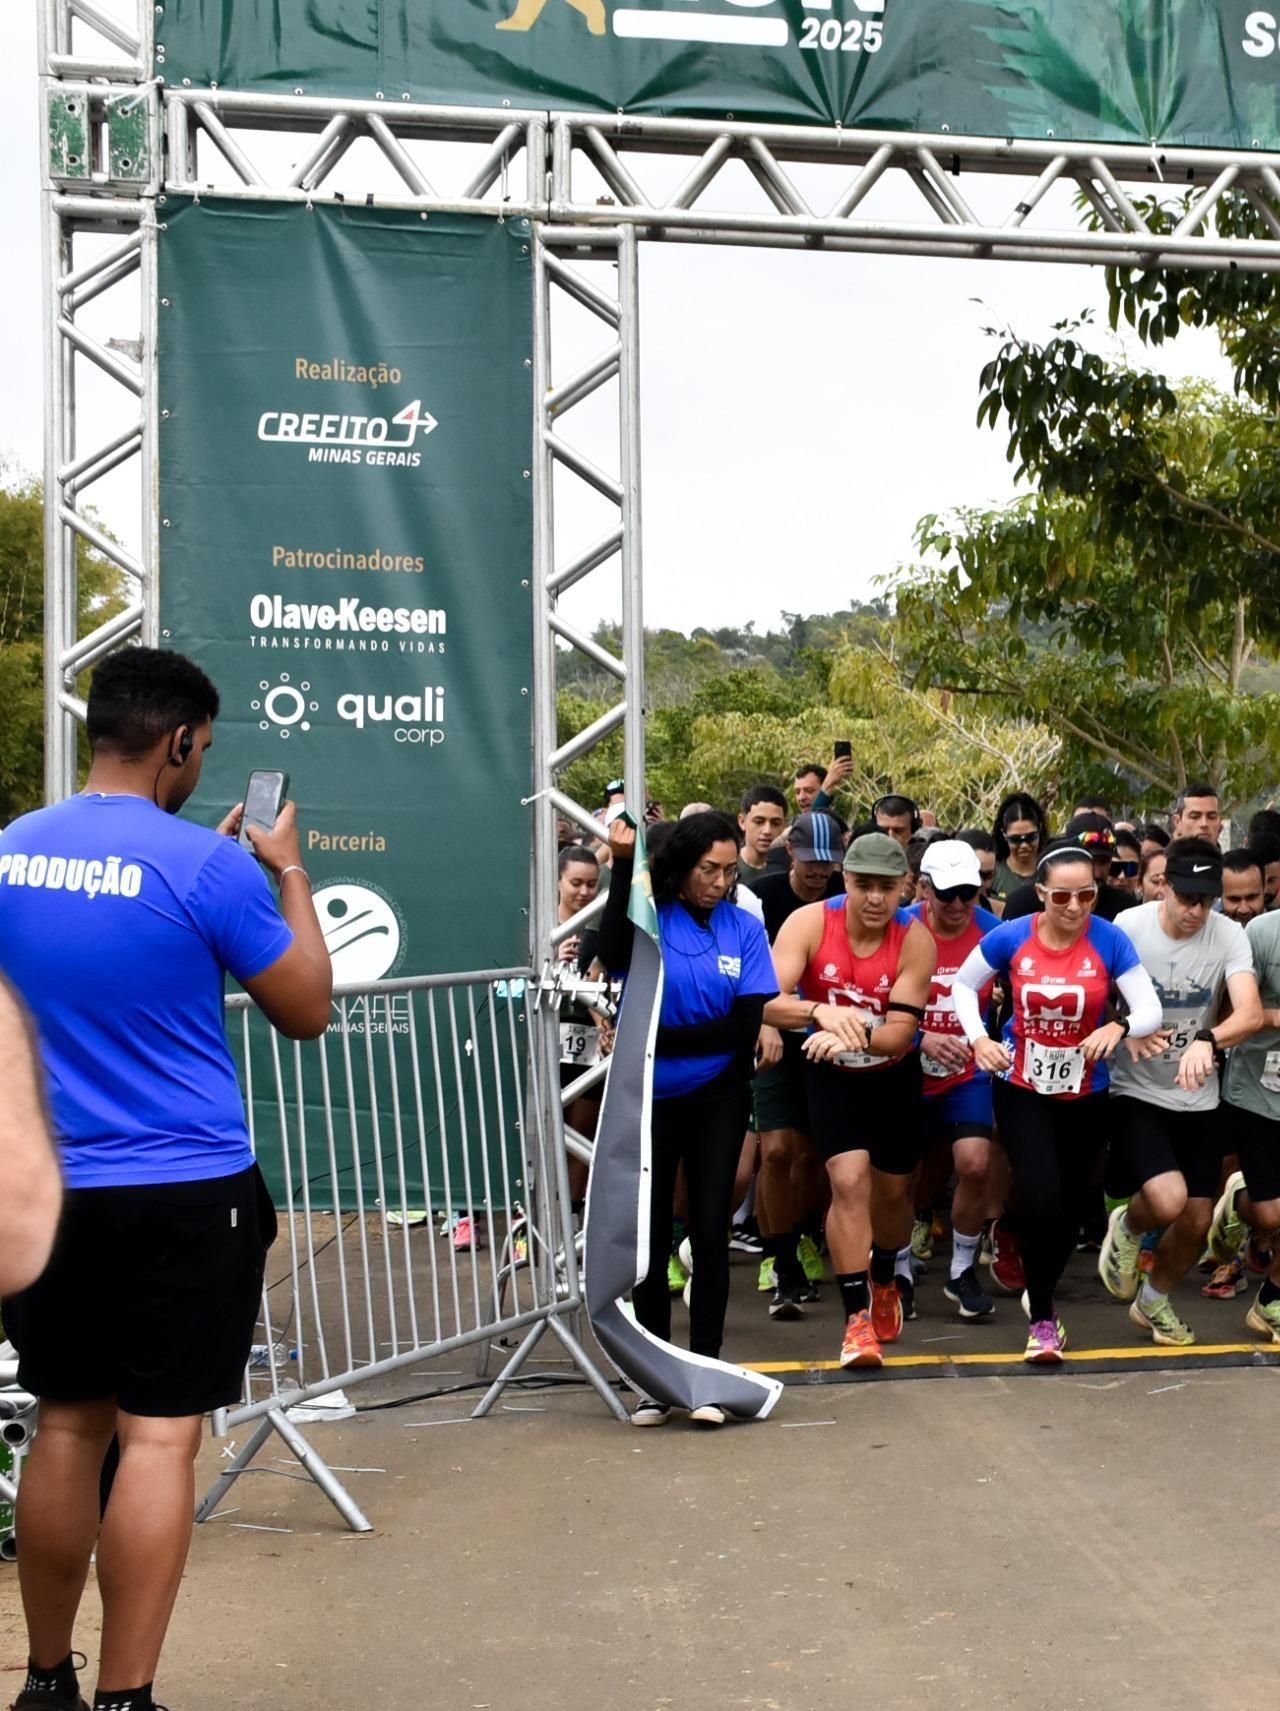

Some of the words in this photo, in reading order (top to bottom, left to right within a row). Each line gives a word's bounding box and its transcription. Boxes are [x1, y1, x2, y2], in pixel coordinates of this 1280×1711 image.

[798, 17, 884, 53] 2025
[294, 357, 402, 389] Realização
[308, 447, 362, 464] MINAS
[365, 450, 422, 467] GERAIS
[272, 545, 425, 573] Patrocinadores
[249, 635, 389, 652] TRANSFORMANDO
[399, 641, 446, 654] VIDAS
[336, 686, 445, 729] quali
[394, 727, 445, 747] corp
[307, 829, 387, 852] Parceria
[0, 853, 143, 899] PRODUÇÃO
[565, 1035, 586, 1052] 19
[1032, 1058, 1072, 1080] 316
